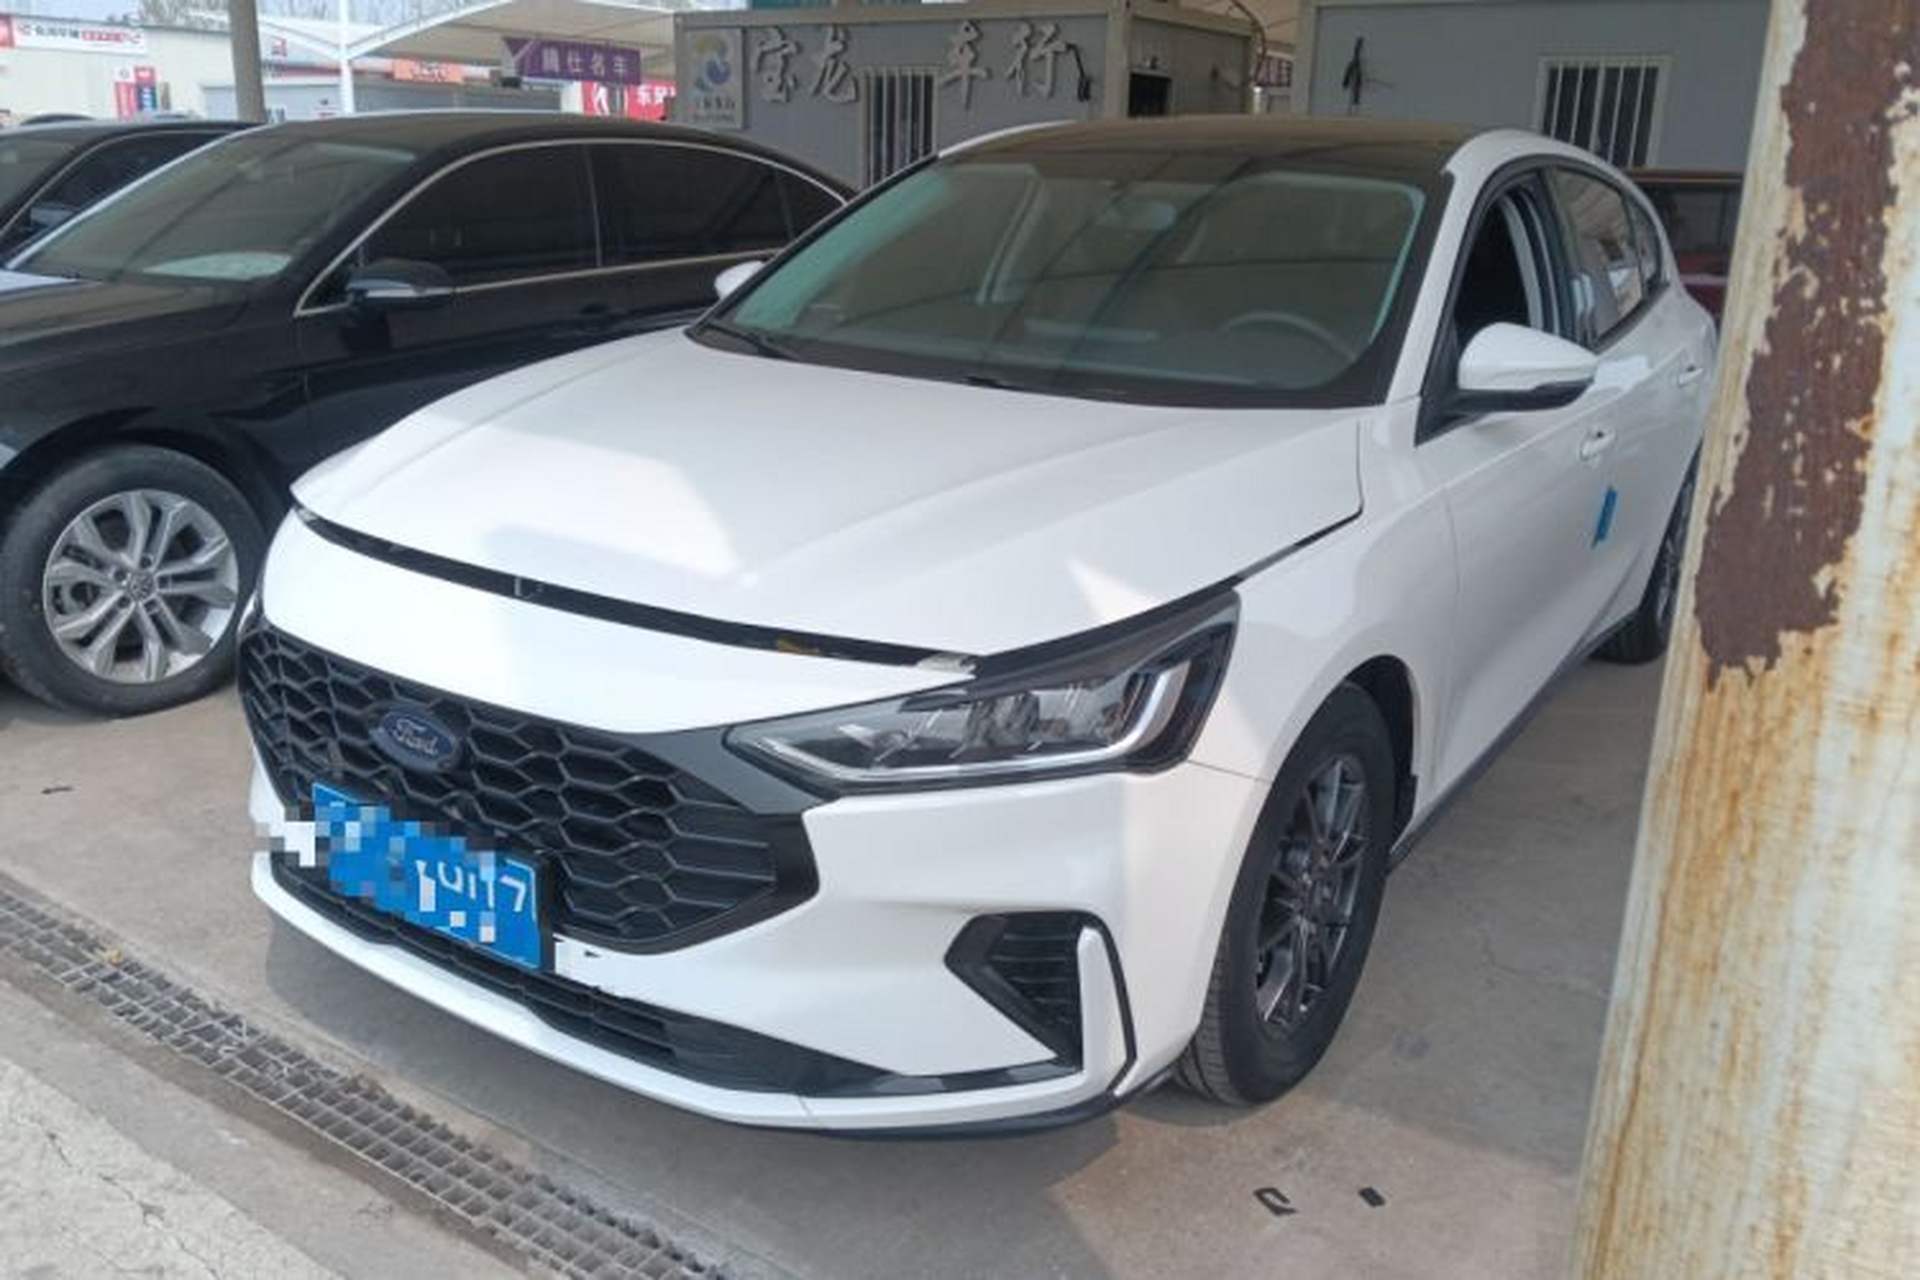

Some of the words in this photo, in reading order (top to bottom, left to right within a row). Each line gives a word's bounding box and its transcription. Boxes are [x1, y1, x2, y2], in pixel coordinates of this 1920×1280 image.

[755, 23, 859, 104] 宝龙
[938, 20, 1068, 110] 车行
[391, 717, 439, 755] Ford
